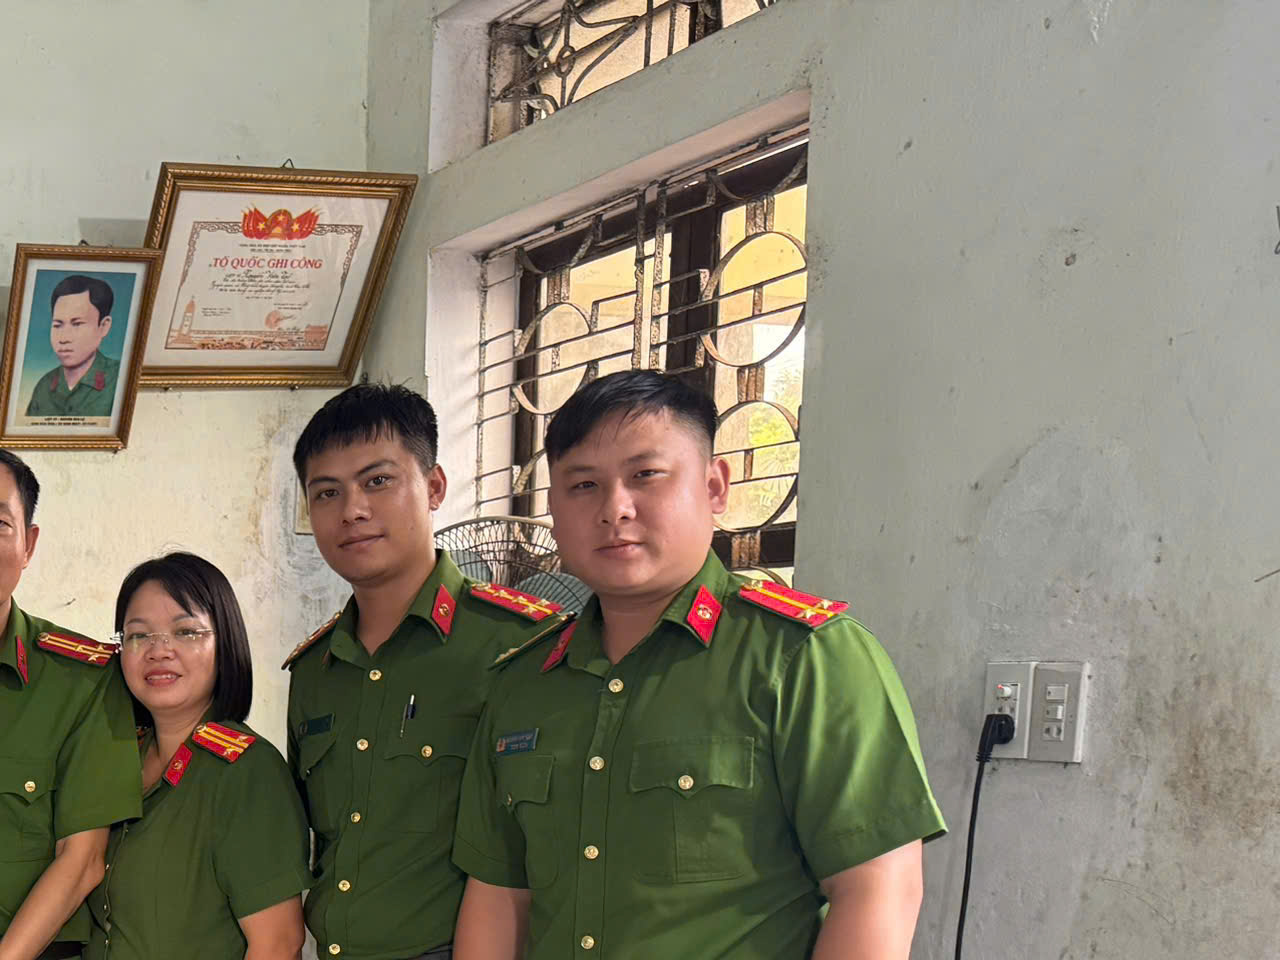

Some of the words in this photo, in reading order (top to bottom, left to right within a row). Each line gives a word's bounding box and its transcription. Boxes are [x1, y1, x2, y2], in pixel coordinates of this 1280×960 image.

[231, 256, 265, 269] QUỐC
[267, 258, 288, 268] GHI
[290, 256, 323, 269] CÔNG
